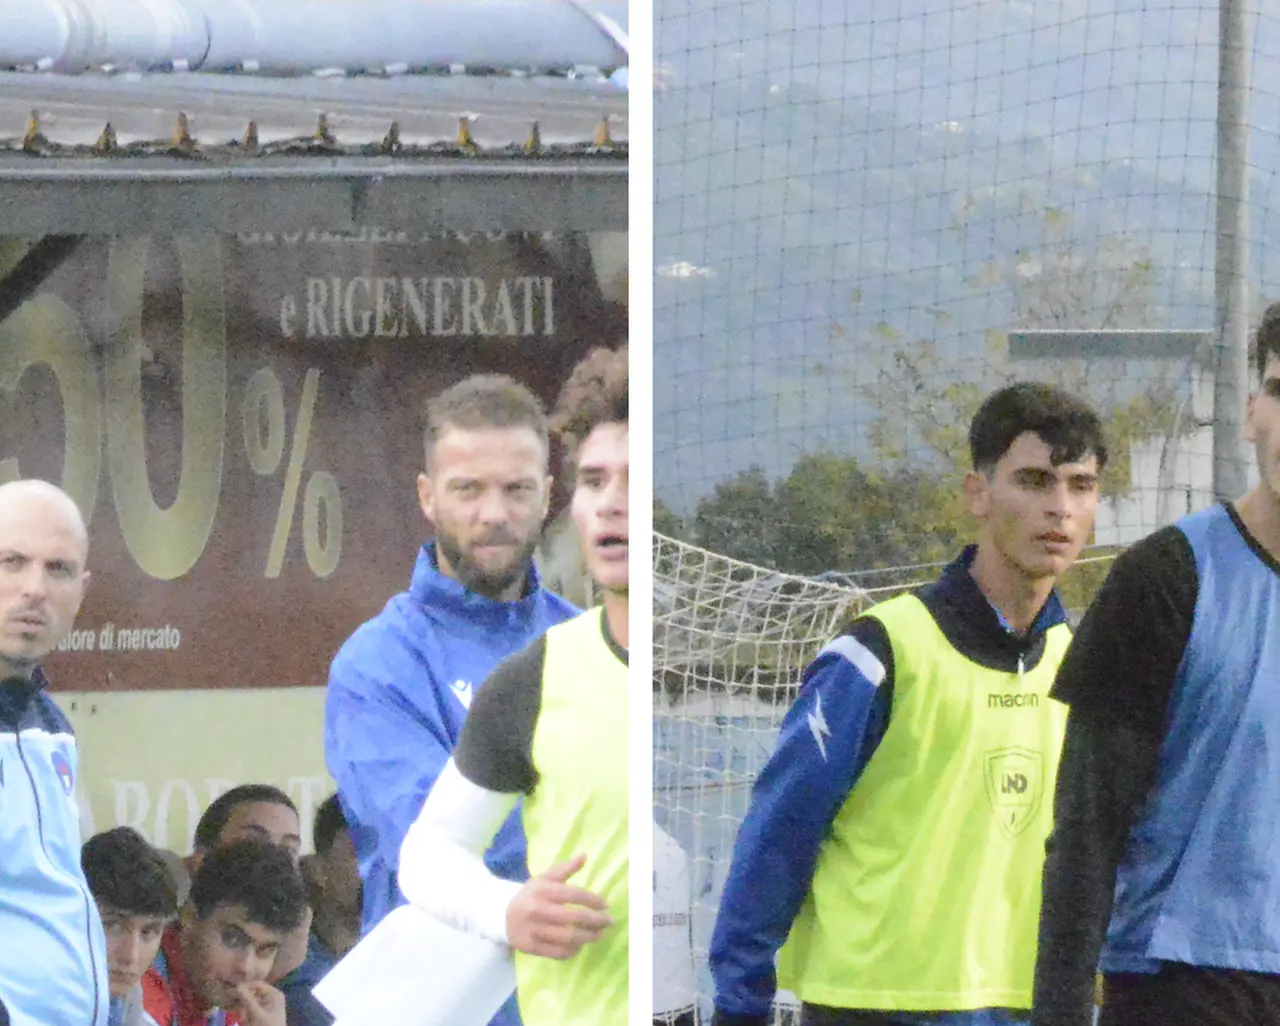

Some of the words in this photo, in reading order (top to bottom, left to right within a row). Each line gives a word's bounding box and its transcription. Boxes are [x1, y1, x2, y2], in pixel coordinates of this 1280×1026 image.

[281, 294, 297, 337] e
[307, 276, 554, 338] RIGENERATI
[57, 627, 95, 651] alore
[100, 622, 115, 650] di
[119, 624, 181, 651] mercato
